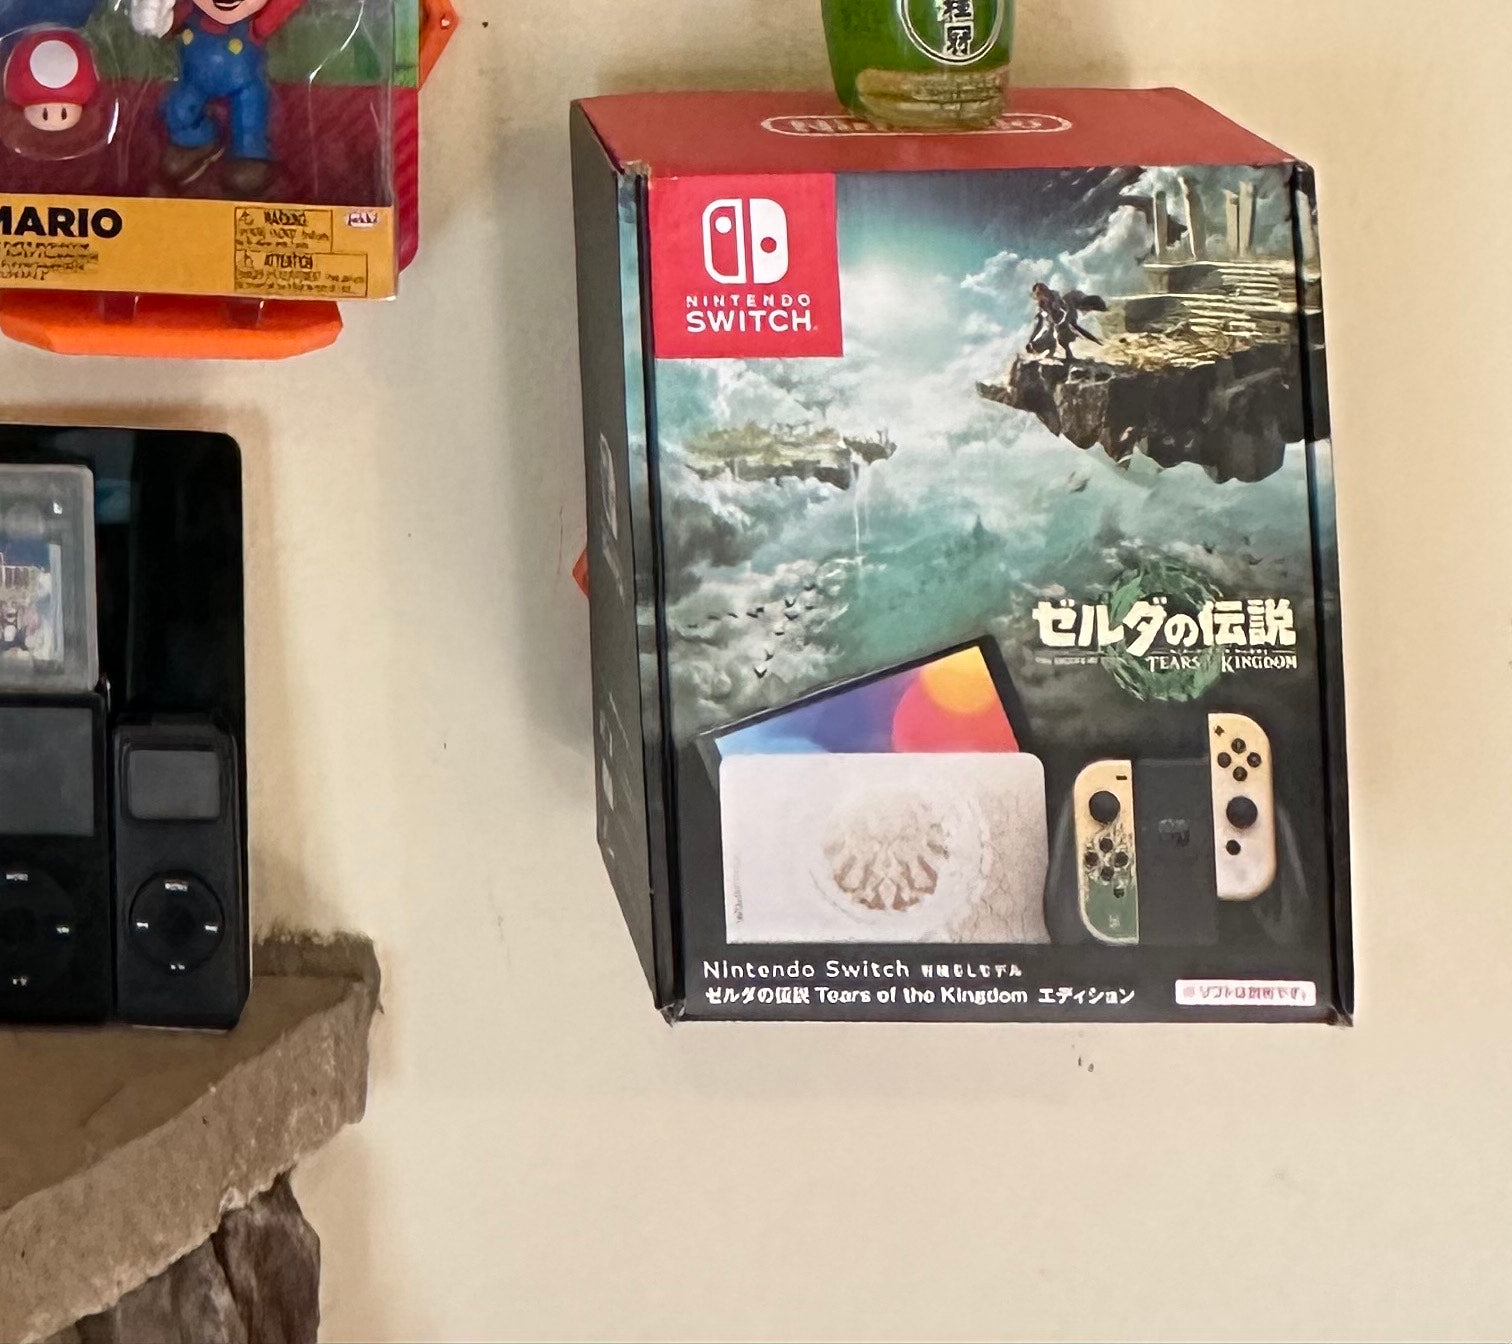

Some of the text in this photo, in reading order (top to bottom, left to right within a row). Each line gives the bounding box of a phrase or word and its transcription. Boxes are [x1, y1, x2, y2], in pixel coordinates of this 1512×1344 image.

[685, 293, 811, 308] NINTENDO
[685, 309, 812, 333] SWITCH
[1031, 597, 1298, 657] ゼルダの伝説
[1145, 655, 1201, 673] TEARS
[1221, 654, 1298, 673] KINGDOM
[703, 960, 815, 979] Nintendo
[826, 960, 910, 978] Switch
[814, 986, 872, 1004] Tears
[876, 985, 897, 1004] of
[903, 985, 936, 1004] the
[941, 986, 1029, 1006] Kingdom
